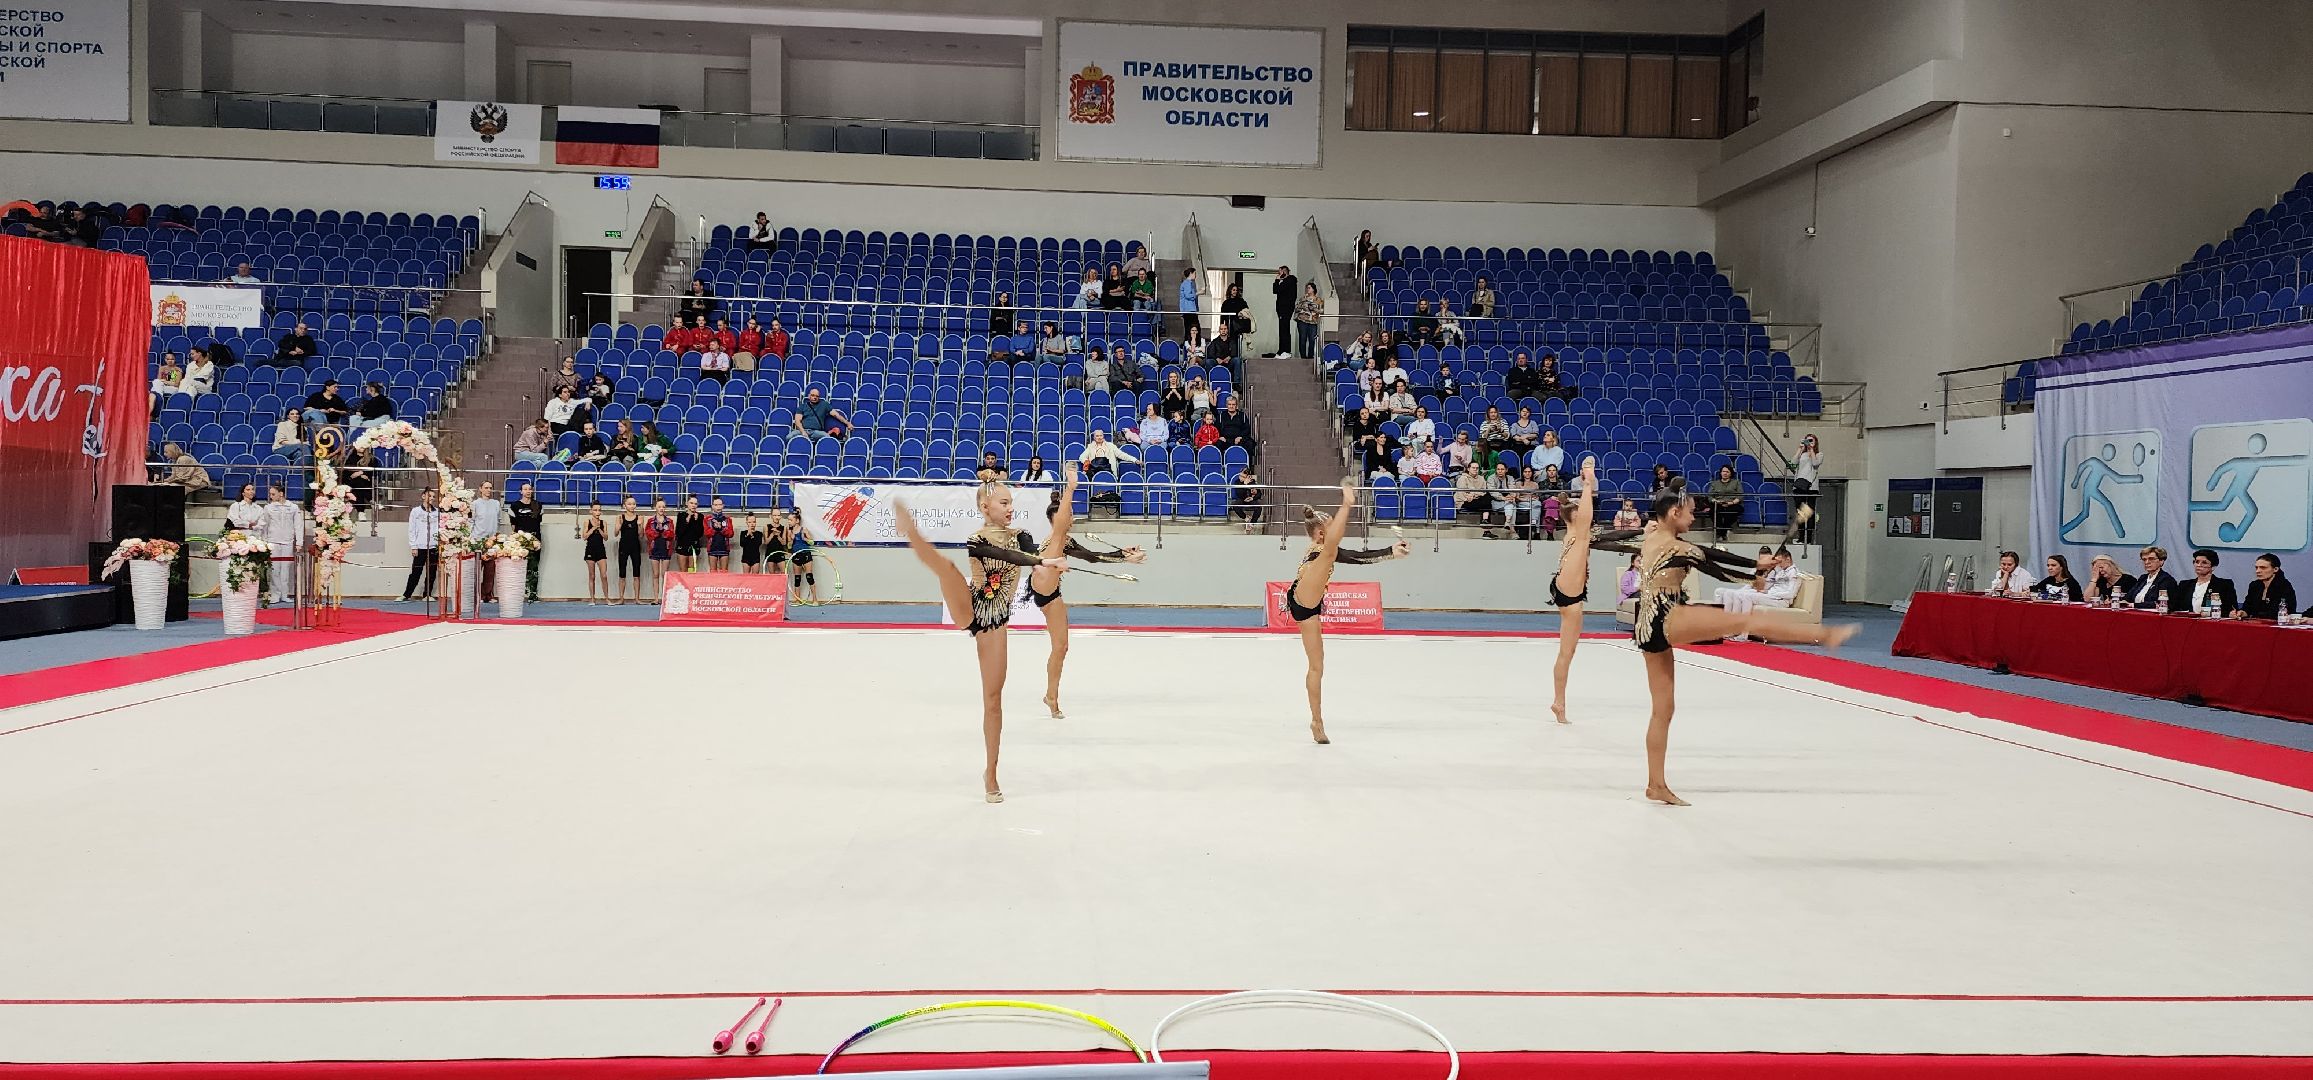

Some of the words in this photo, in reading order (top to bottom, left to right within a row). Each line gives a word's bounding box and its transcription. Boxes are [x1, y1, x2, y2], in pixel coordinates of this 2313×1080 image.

[0, 24, 44, 37] СКОЙ
[19, 41, 30, 52] И
[35, 41, 104, 54] СПОРТА
[0, 54, 45, 68] СКОЙ
[1123, 61, 1313, 83] ПРАВИТЕЛЬСТВО
[1142, 85, 1293, 105] МОСКОВСКОЙ
[1165, 110, 1269, 128] ОБЛАСТИ
